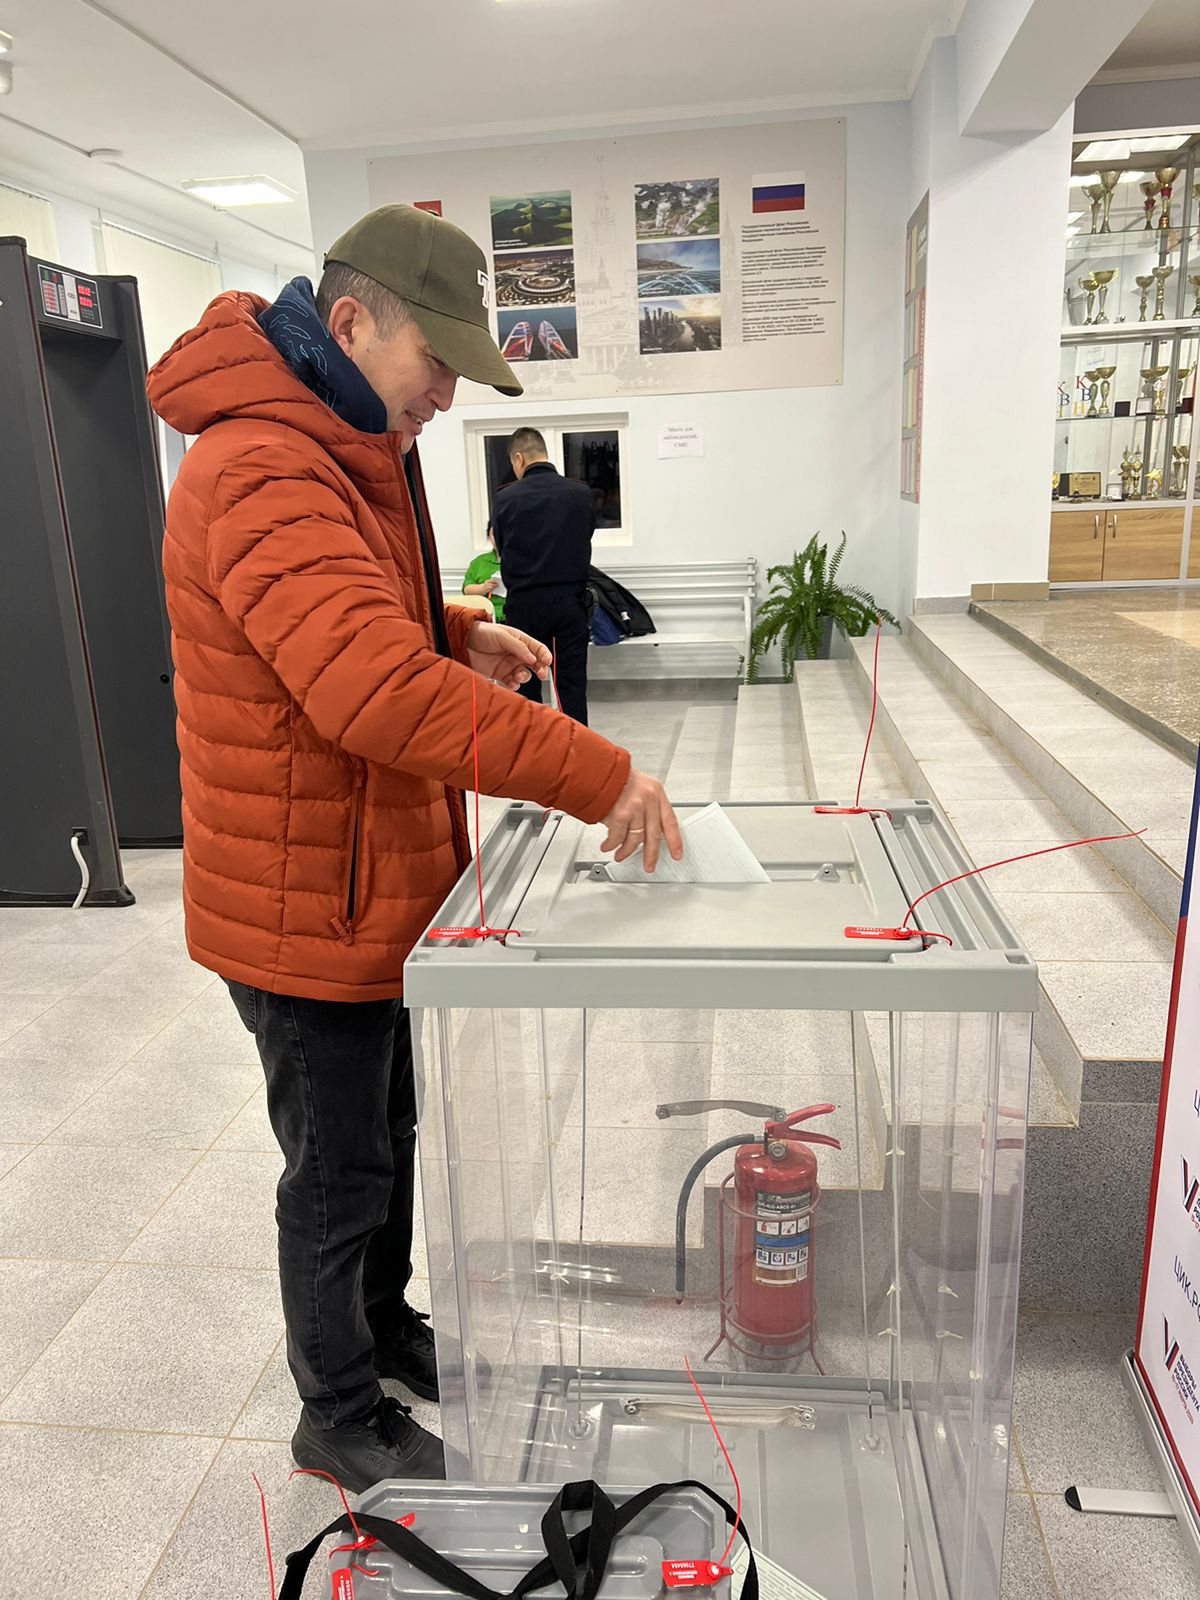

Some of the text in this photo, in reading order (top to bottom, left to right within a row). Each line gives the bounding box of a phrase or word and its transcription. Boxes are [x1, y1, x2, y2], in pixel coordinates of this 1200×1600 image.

[1173, 1367, 1189, 1400] РОССИИ
[1176, 1360, 1200, 1412] ПРЕЗИДЕНТА
[1180, 1353, 1197, 1390] ВЫБОРЫ
